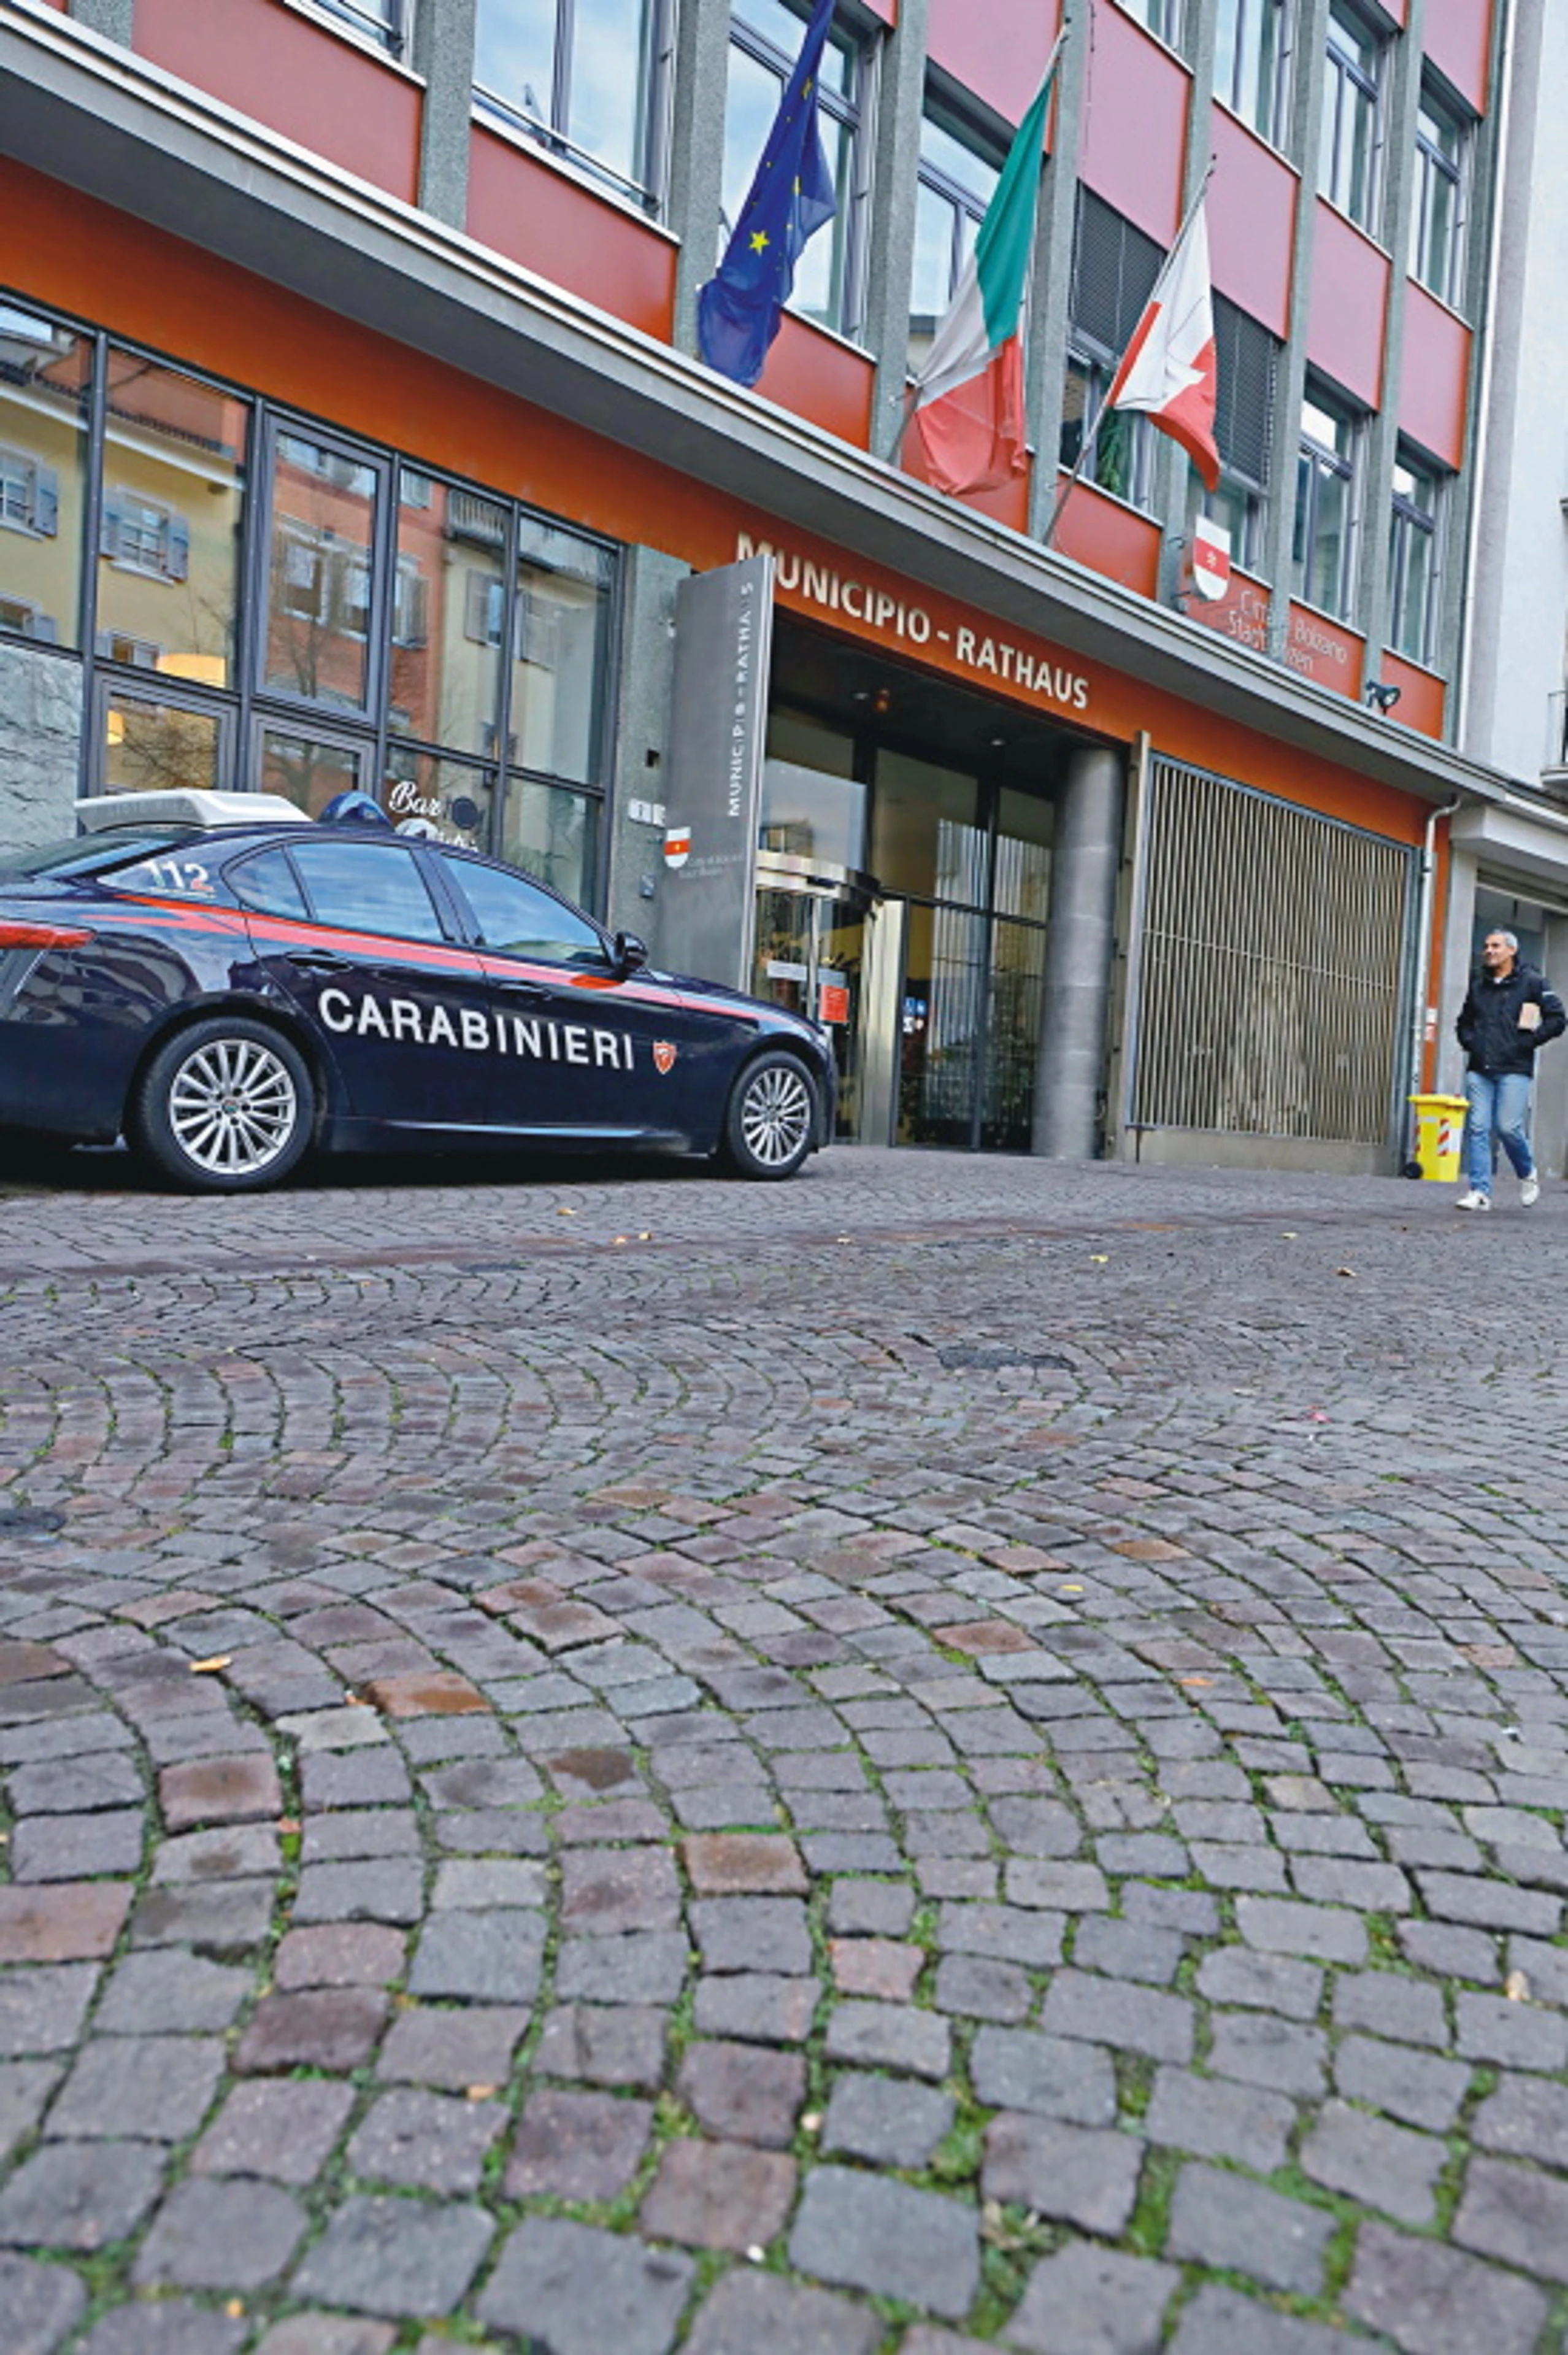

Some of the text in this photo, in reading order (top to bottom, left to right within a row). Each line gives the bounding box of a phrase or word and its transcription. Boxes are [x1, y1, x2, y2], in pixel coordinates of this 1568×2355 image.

[956, 626, 1089, 709] RATHAUS
[388, 781, 442, 817] Bar
[728, 703, 745, 817] MUNICIPIO
[142, 860, 215, 892] 112
[318, 988, 634, 1071] CARABINIERI
